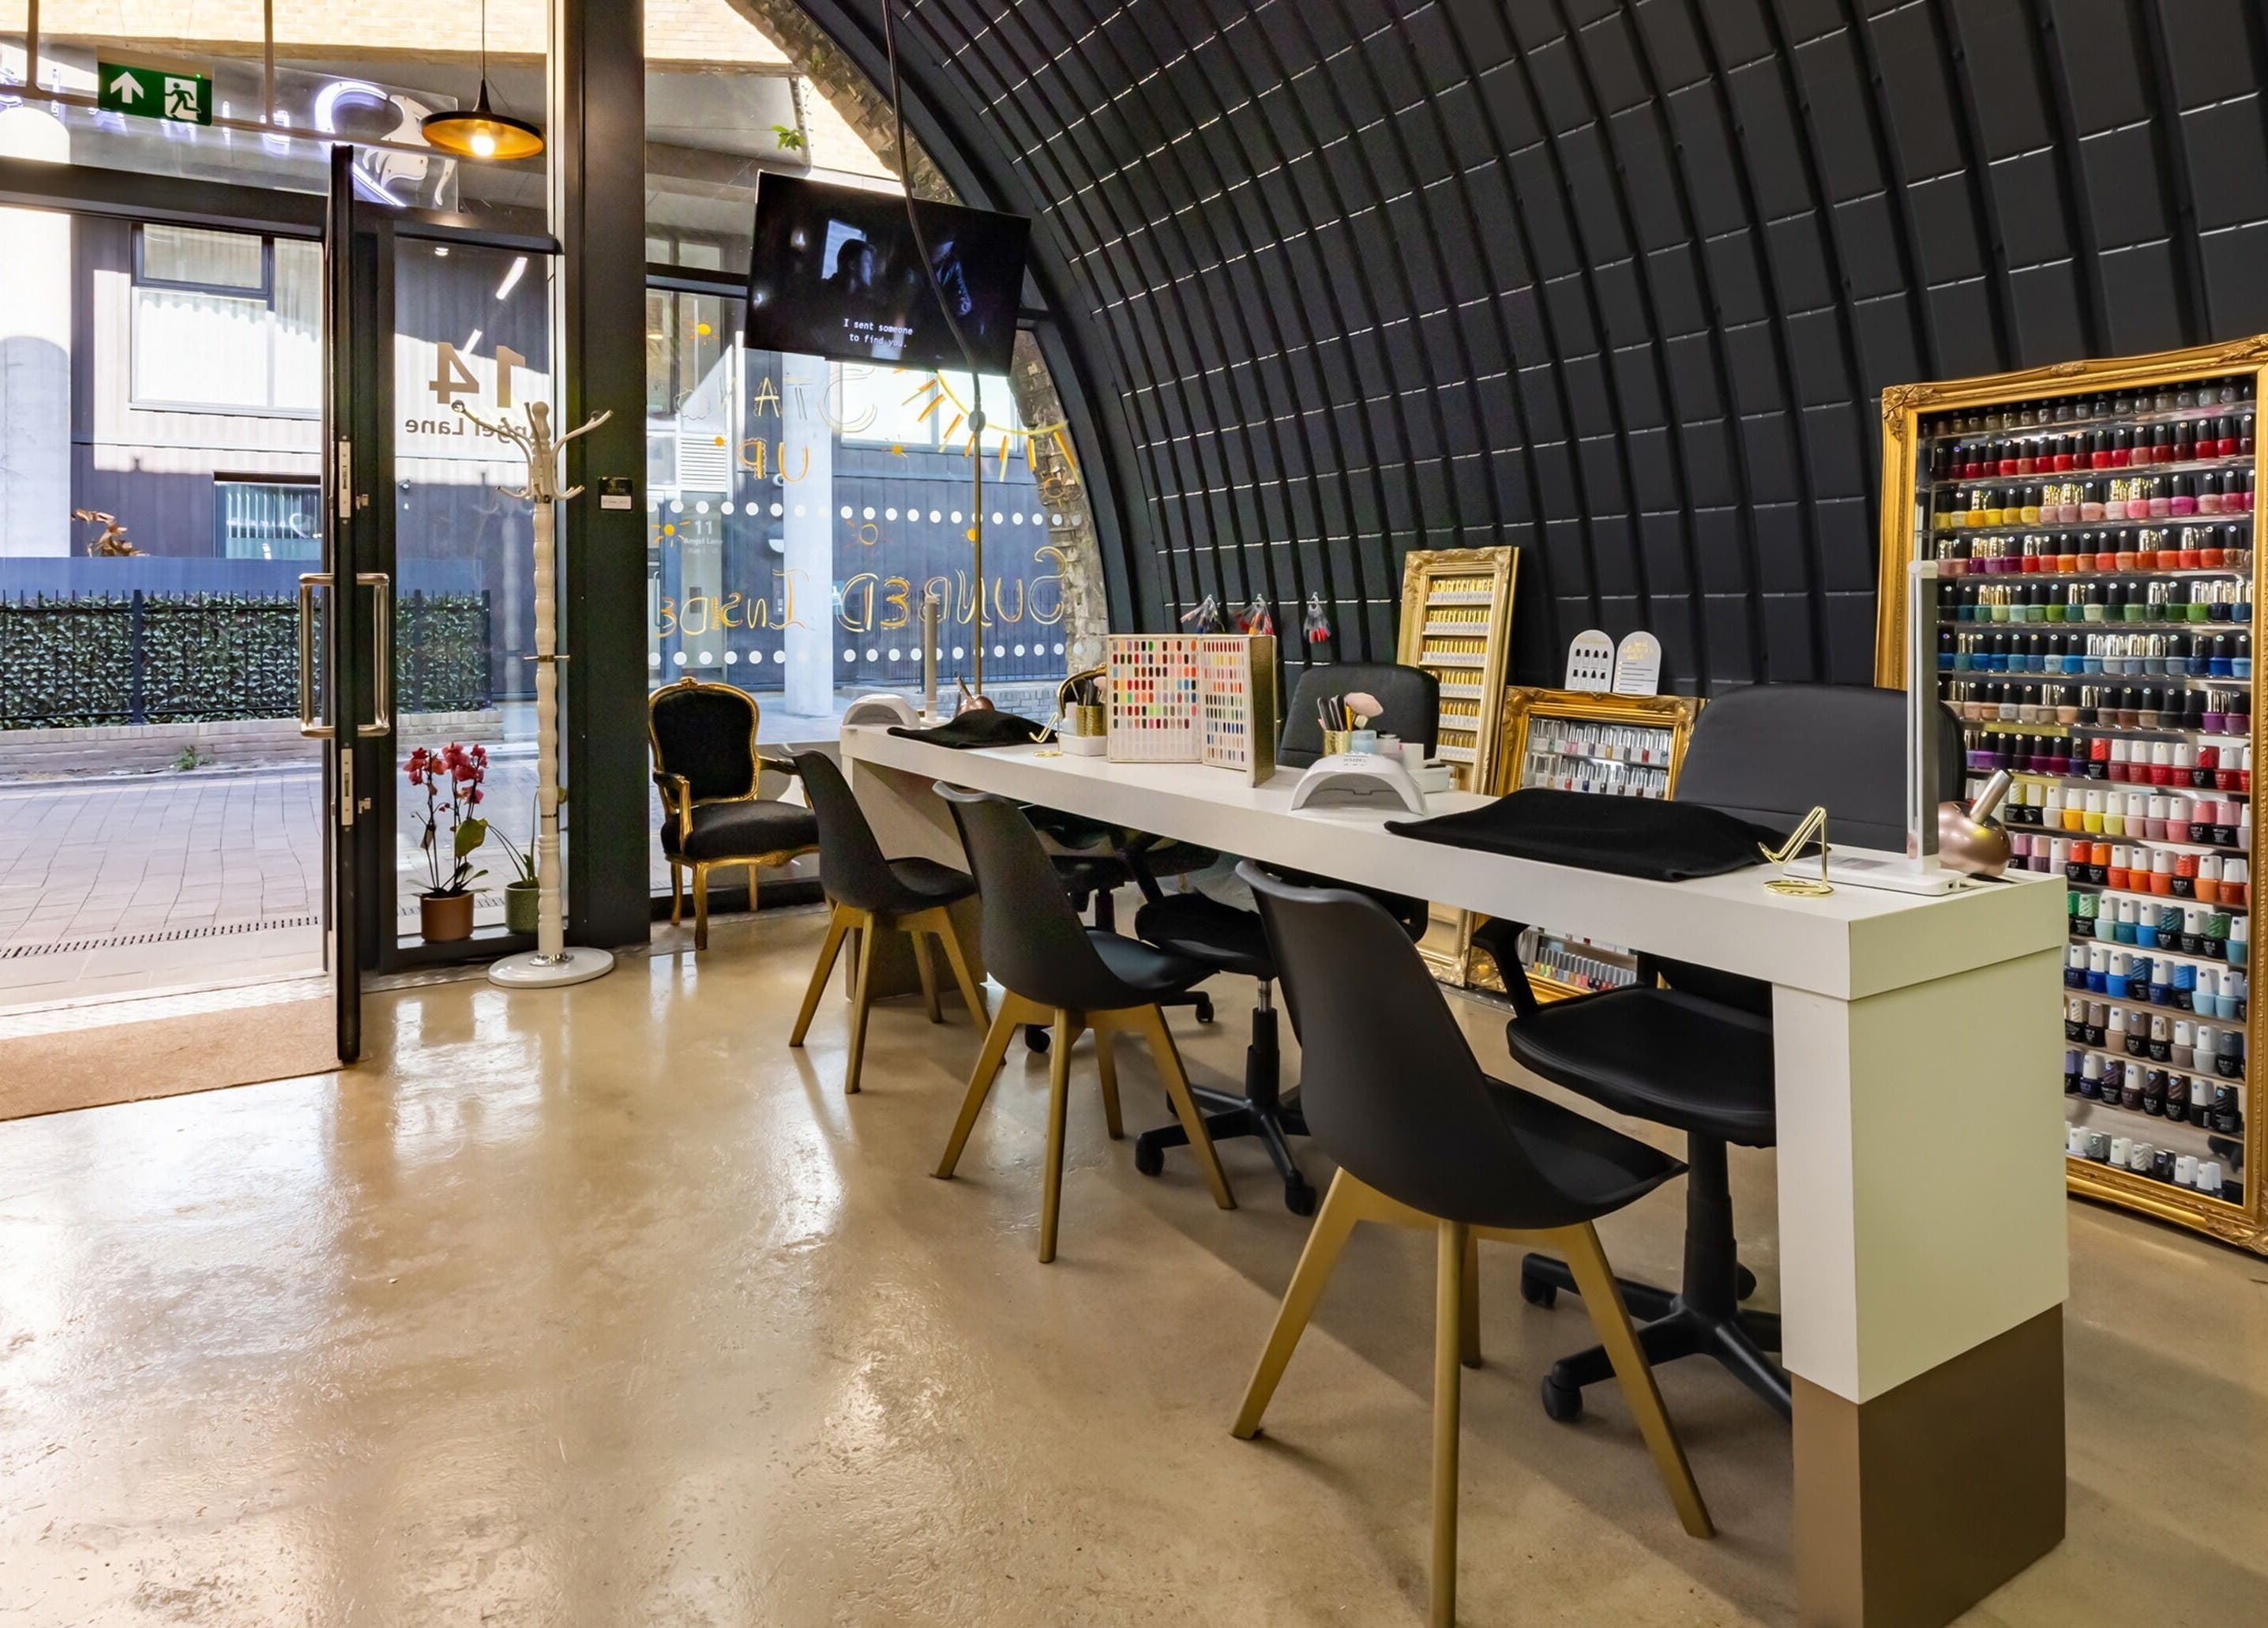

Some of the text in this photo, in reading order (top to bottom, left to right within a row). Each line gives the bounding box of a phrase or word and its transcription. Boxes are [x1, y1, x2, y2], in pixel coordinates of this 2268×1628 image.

[843, 318, 914, 335] I sent someone
[864, 334, 884, 344] find
[888, 339, 907, 348] you.
